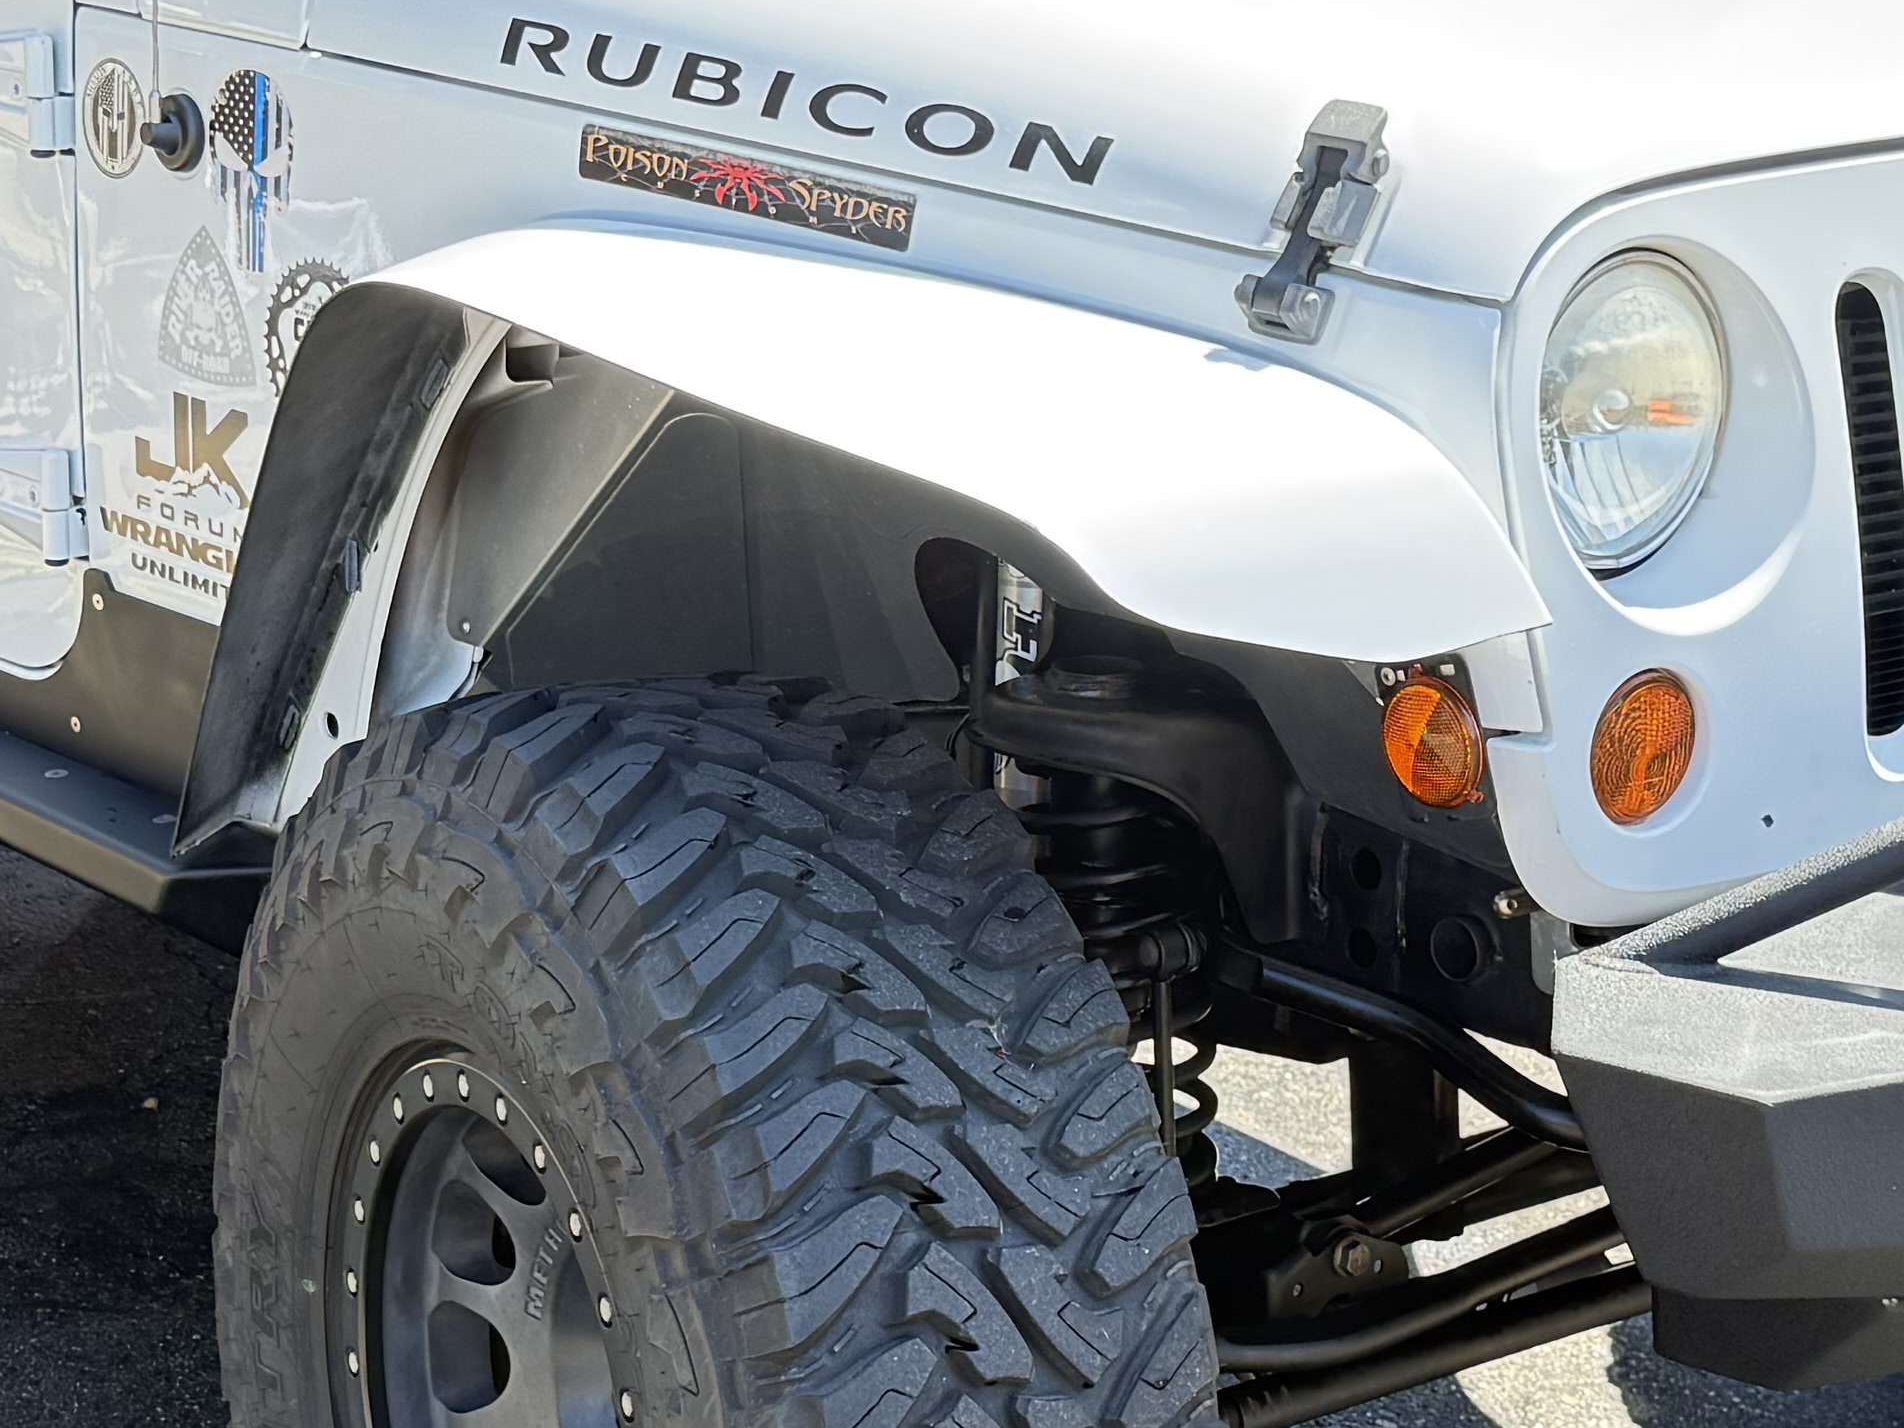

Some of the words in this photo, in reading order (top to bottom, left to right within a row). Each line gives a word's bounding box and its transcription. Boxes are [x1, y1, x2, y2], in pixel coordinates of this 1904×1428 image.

[499, 17, 1115, 186] RUBICON
[585, 133, 689, 181] POISON
[788, 178, 907, 234] SPYDER
[203, 260, 244, 359] RAIDER
[135, 391, 250, 509] JK
[523, 1218, 567, 1321] METH
